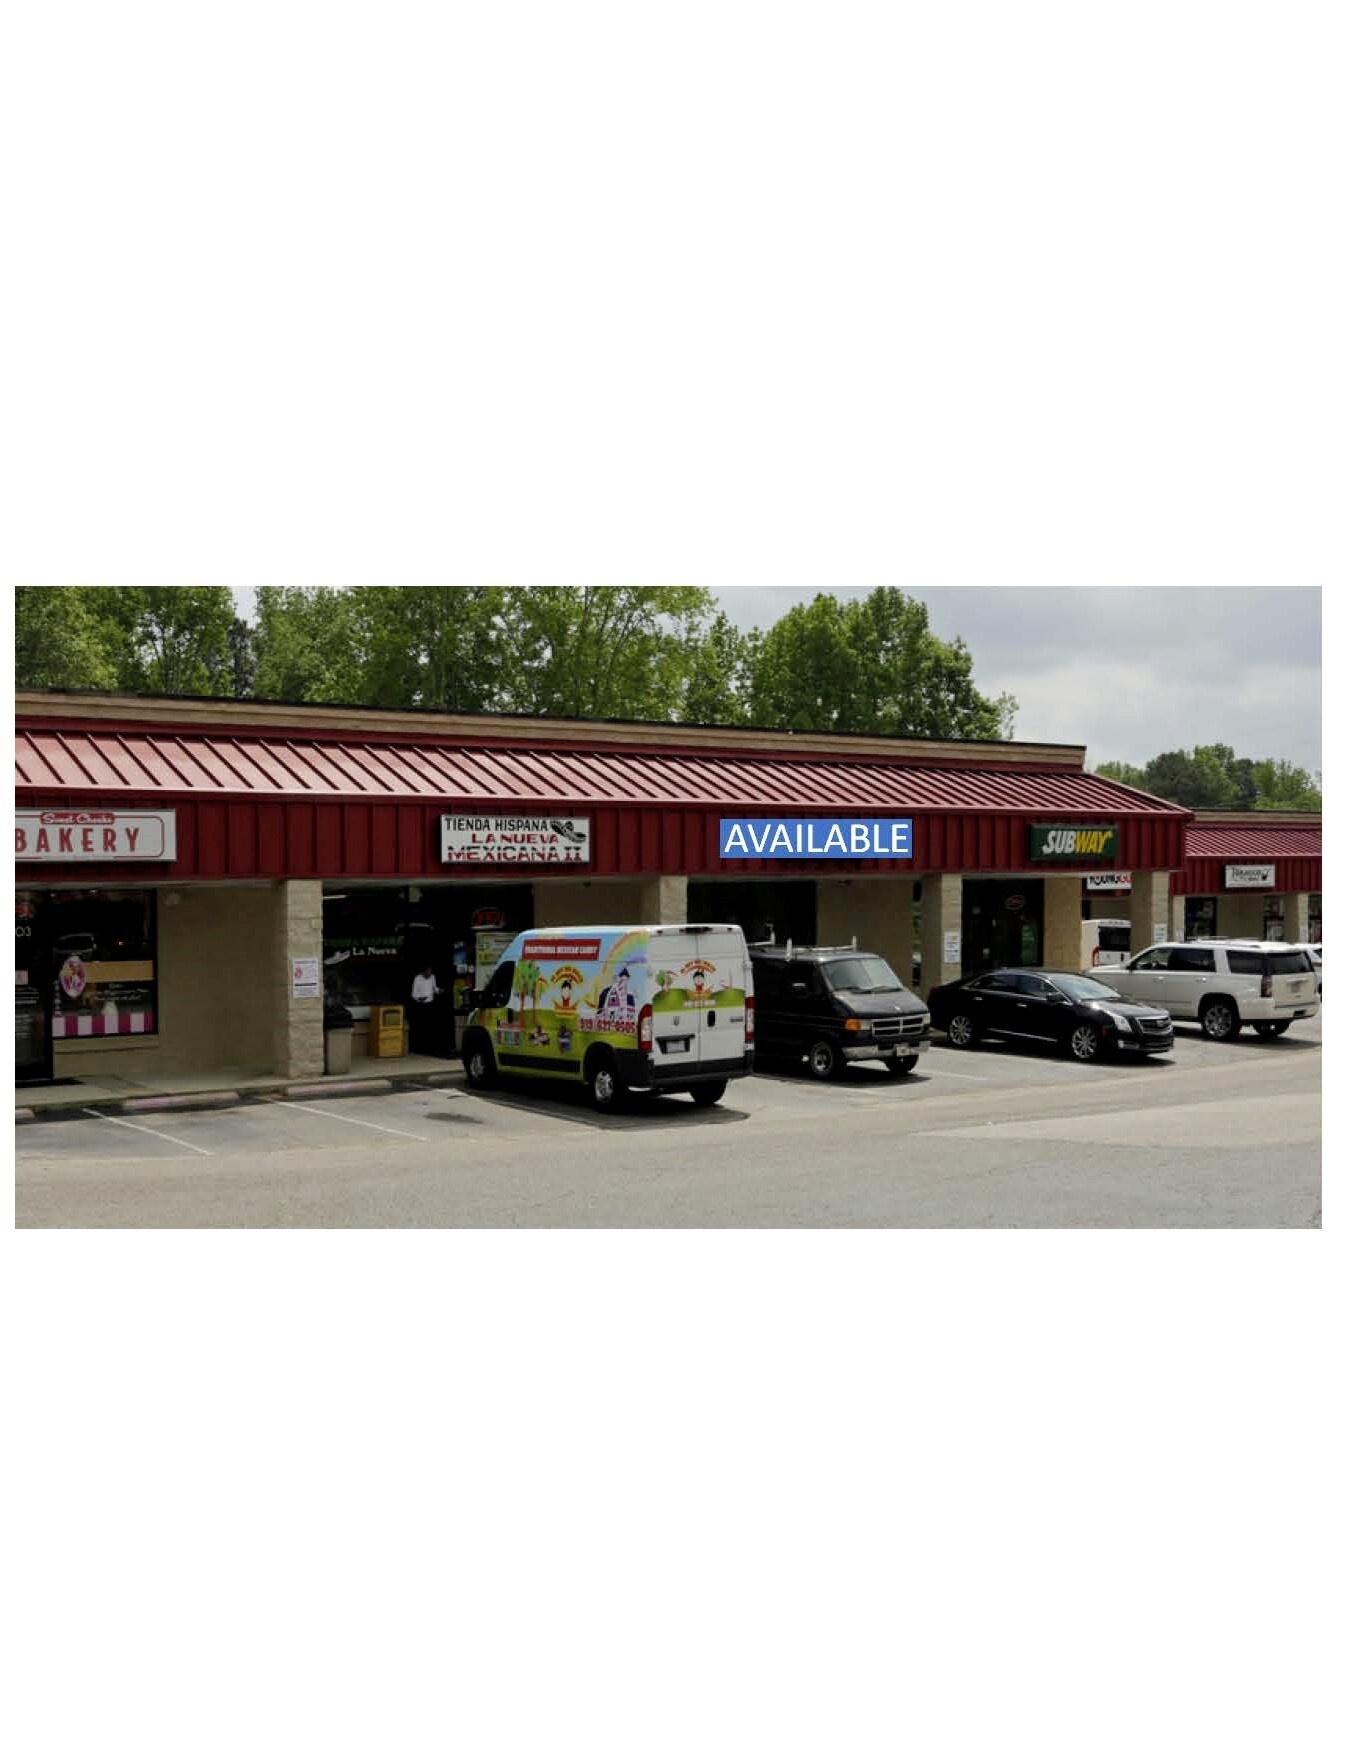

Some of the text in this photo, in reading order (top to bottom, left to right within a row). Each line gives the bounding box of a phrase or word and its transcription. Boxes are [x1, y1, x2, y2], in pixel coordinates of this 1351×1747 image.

[444, 817, 548, 832] TIENDA HISPANA
[15, 827, 139, 852] BAKERY
[471, 833, 560, 844] LA NUEVA
[1042, 829, 1114, 854] SUBWAY
[447, 845, 560, 861] MEXICANA
